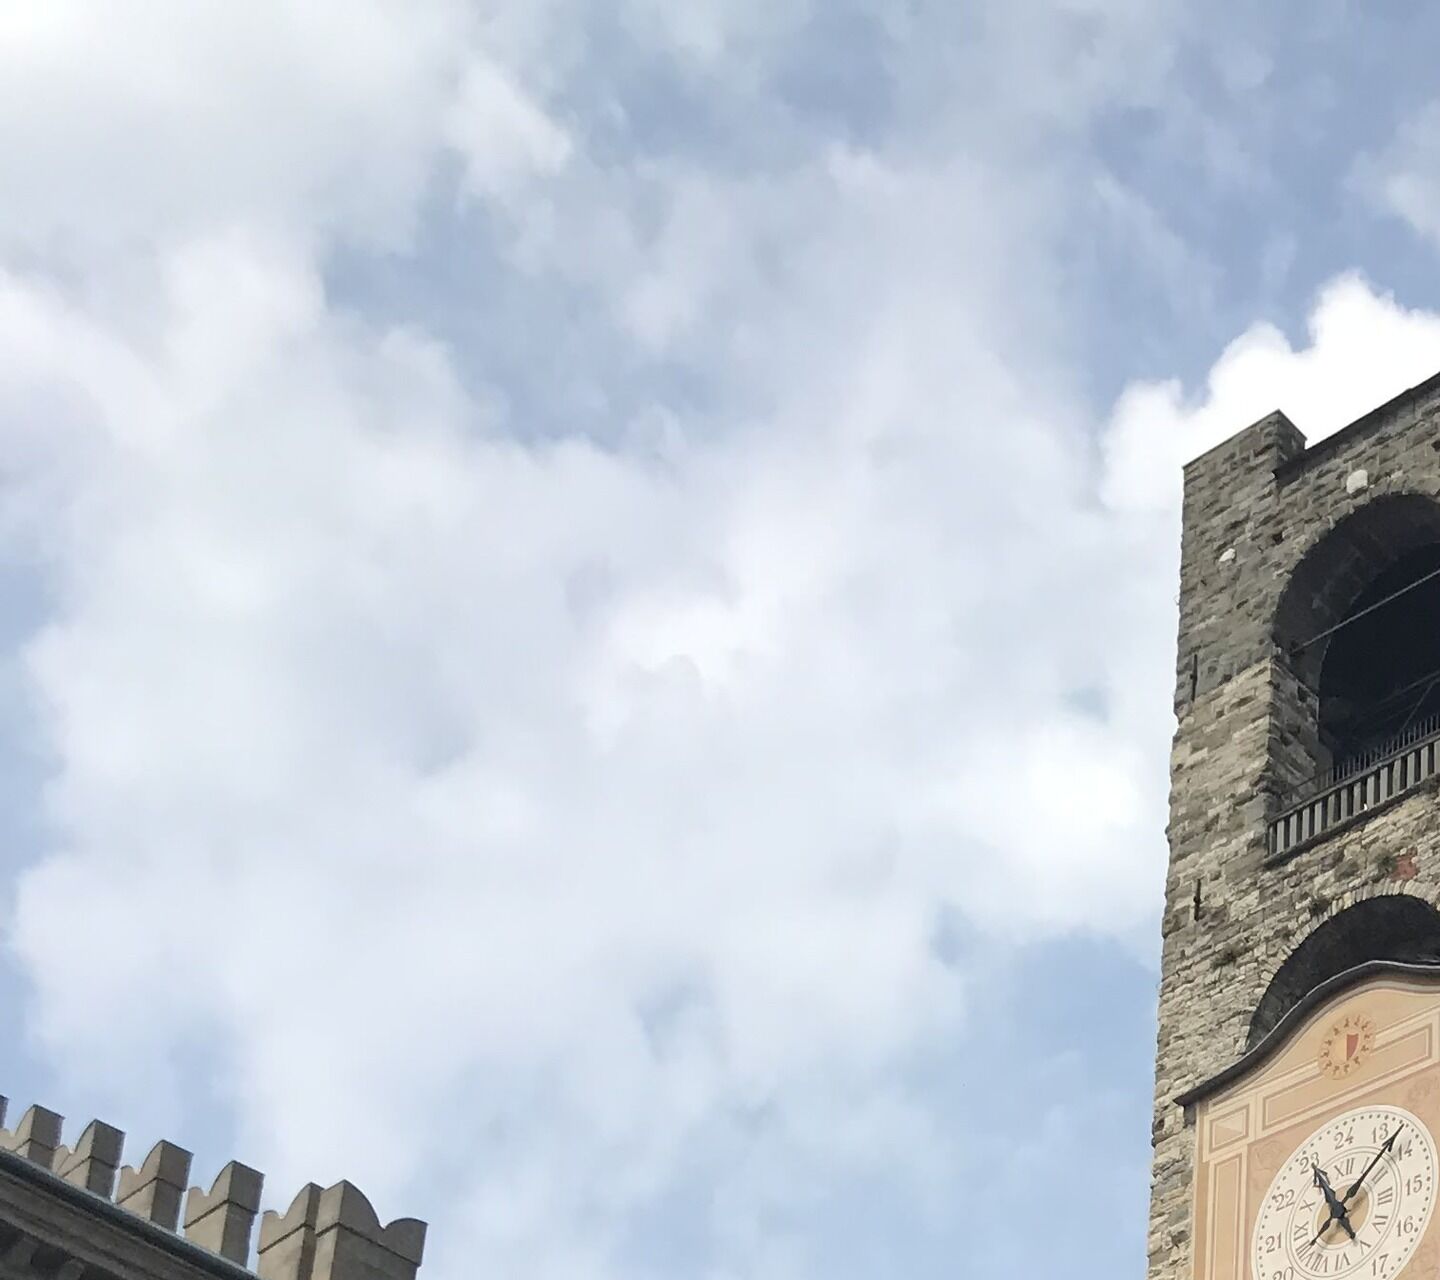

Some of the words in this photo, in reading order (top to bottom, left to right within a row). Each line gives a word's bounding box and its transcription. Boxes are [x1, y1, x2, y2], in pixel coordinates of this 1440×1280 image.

[1334, 1126, 1354, 1150] 24
[1372, 1122, 1389, 1143] 13
[1397, 1139, 1413, 1161] 14
[1299, 1152, 1320, 1175] 23
[1334, 1157, 1355, 1180] XII
[1405, 1174, 1423, 1196] 15
[1273, 1189, 1295, 1211] 22
[1299, 1199, 1316, 1212] X
[1396, 1215, 1414, 1237] 16
[1265, 1232, 1282, 1253] 21
[1371, 1253, 1389, 1276] 17
